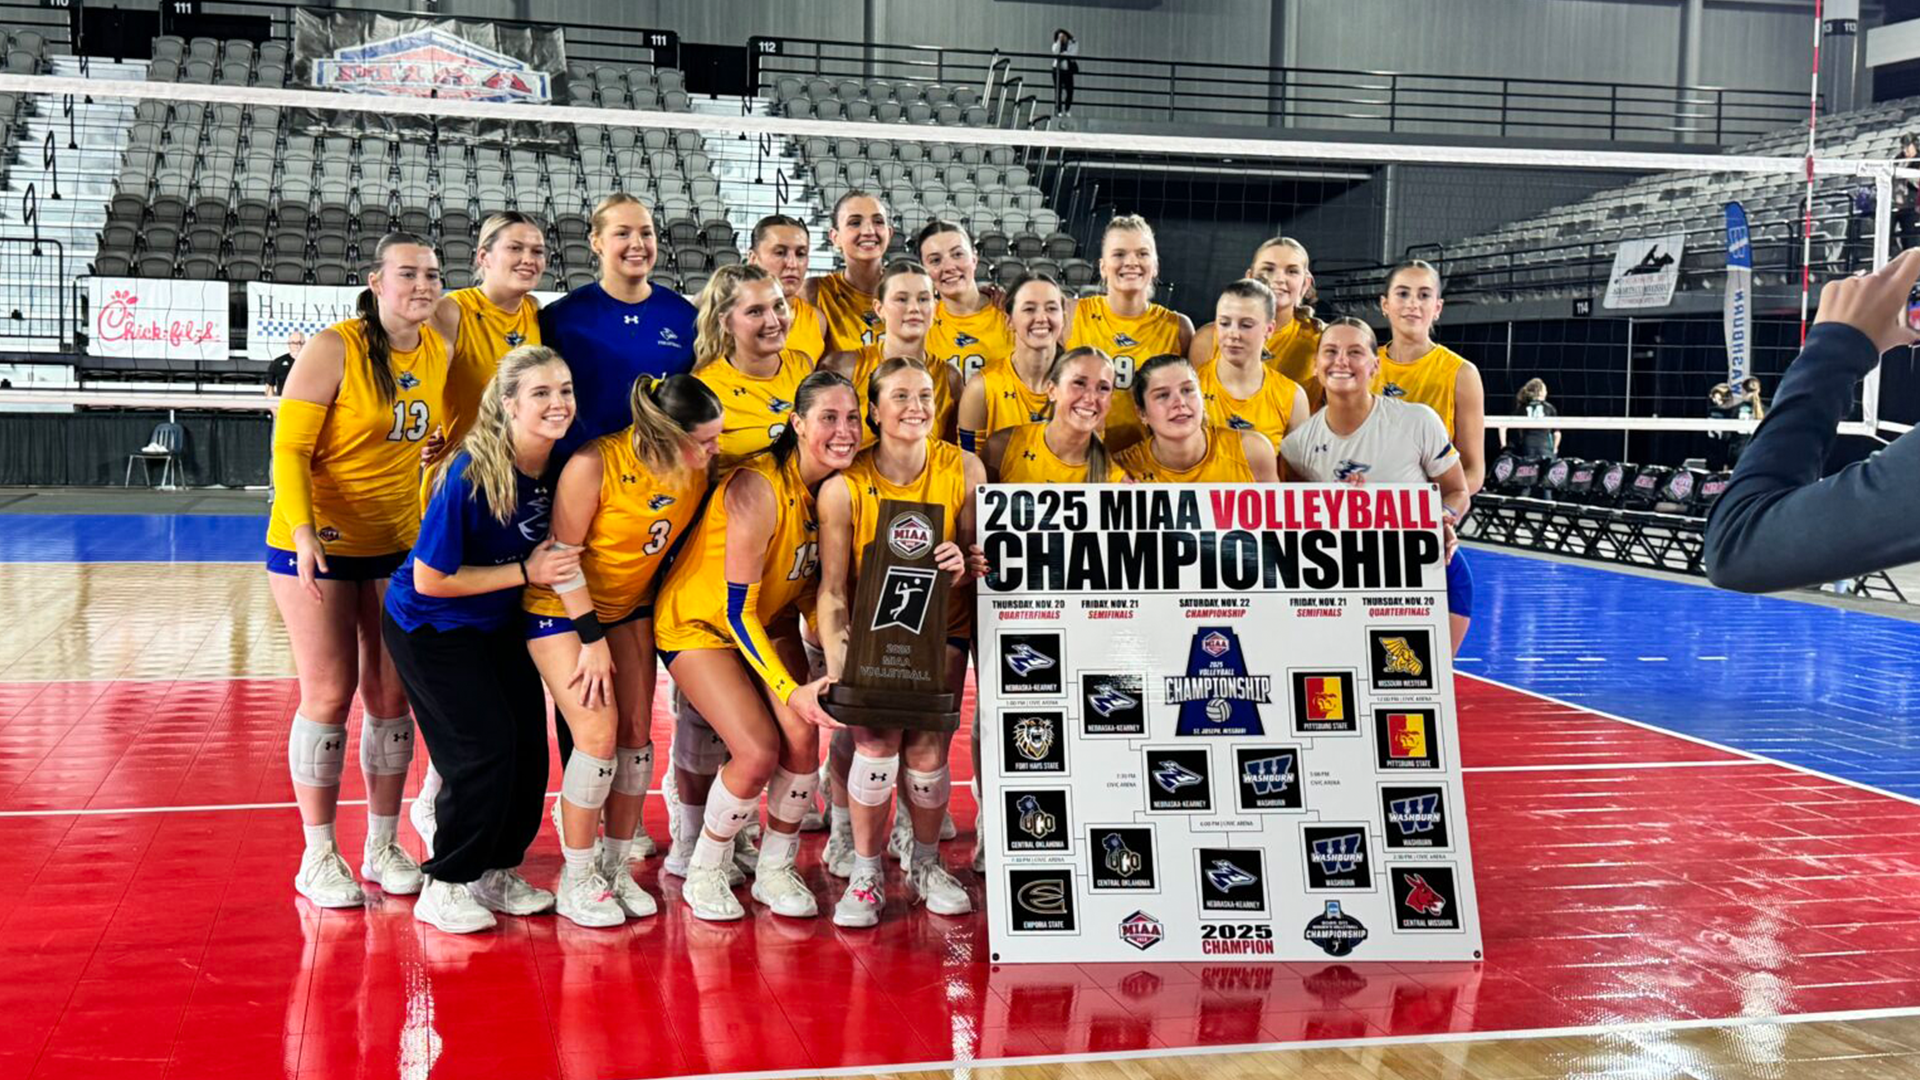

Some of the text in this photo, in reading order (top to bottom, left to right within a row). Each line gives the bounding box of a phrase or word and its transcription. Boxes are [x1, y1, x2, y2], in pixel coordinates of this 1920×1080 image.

[174, 2, 191, 14] 111
[650, 35, 667, 46] 111
[758, 41, 776, 53] 112
[258, 294, 352, 322] HILLYAR
[1576, 301, 1589, 314] 114
[98, 298, 219, 347] Chick-fil-A
[1113, 355, 1135, 390] 9
[386, 400, 430, 441] 13
[984, 489, 1438, 531] 2025 MIAA VOLLEYBALL
[642, 519, 672, 556] 3
[894, 529, 928, 542] MIAA
[786, 541, 819, 580] 15
[984, 530, 1440, 592] CHAMPIONSHIP
[992, 600, 1065, 609] THURSDAY, NOV. 20
[1081, 600, 1139, 609] FRIDAY, NOV. 21
[1179, 599, 1250, 608] SATURDAY, NOV. 22
[1290, 598, 1347, 607] FRIDAY, NOV. 21
[1362, 597, 1435, 606] THURSDAY, NOV. 20
[998, 610, 1061, 620] QUARTERFINALS
[1088, 610, 1134, 620] SEMIFINALS
[1185, 609, 1246, 618] CHAMPIONSHIP
[1296, 608, 1343, 618] SEMIFINALS
[1369, 607, 1431, 617] QUARTERFINALS
[1204, 640, 1227, 648] MIAA
[860, 665, 931, 681] VOLLEYBALL
[1199, 668, 1234, 676] VOLLEYBALL
[1004, 683, 1057, 691] NEBRASKA-KEARNEY
[1166, 677, 1271, 704] CHAMPIONSHIP
[1087, 724, 1140, 732] NEBRASKA-KEARNEY
[1332, 722, 1348, 730] STATE
[1015, 762, 1059, 770] FORT HAYS STATE
[1242, 772, 1295, 783] WASHBURN
[1153, 800, 1206, 808] NEBRASKA-KEARNEY
[1256, 799, 1286, 807] WASHBURN
[1388, 812, 1441, 823] WASHBURN
[1011, 841, 1034, 849] CENTRAL
[1311, 852, 1363, 862] WASHBURN
[1097, 879, 1120, 887] CENTRAL
[1206, 900, 1260, 909] NEBRASKA-KEARNEY
[1023, 920, 1064, 929] EMPORIA STATE
[1403, 919, 1453, 927] CENTRAL MISSOURI
[1121, 923, 1161, 936] MIAA
[1200, 924, 1273, 940] 2025
[1305, 929, 1367, 939] CHAMPIONSHIP
[1202, 940, 1274, 954] CHAMPION
